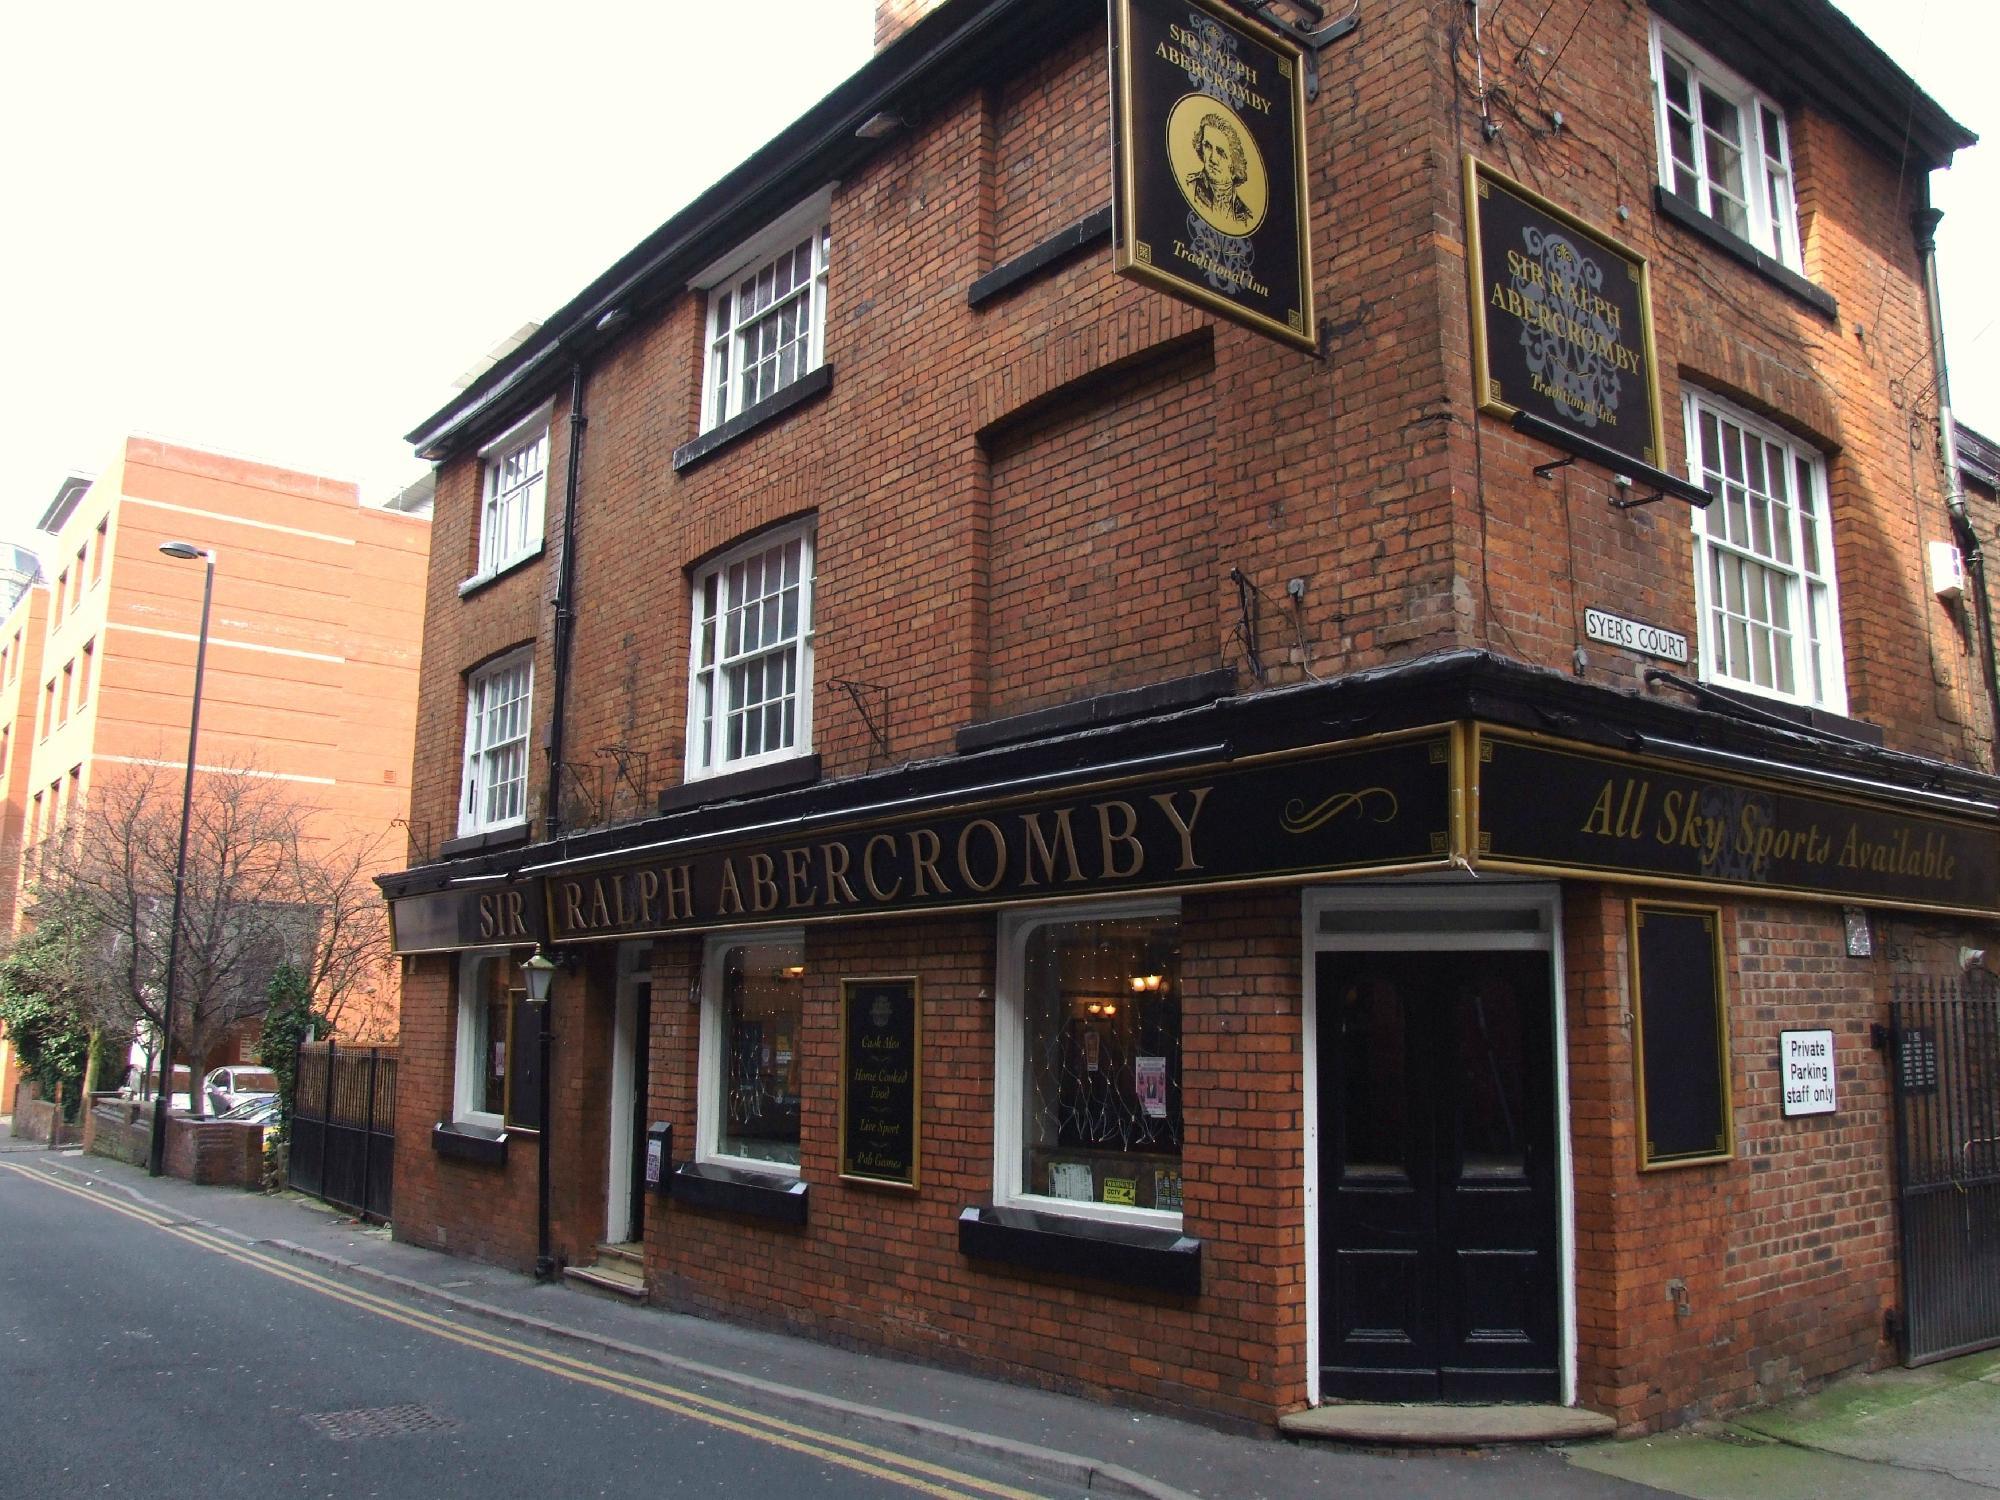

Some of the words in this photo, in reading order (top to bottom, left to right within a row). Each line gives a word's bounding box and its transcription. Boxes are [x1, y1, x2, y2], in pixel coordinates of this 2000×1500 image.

[1169, 23, 1198, 52] SIR
[1200, 38, 1257, 86] RALPH
[1155, 41, 1272, 116] ABERCROMBY
[1173, 239, 1246, 286] Traditional
[1248, 272, 1270, 298] Inn
[1507, 250, 1544, 290] SIR
[1550, 271, 1622, 329] RALPH
[1490, 282, 1641, 377] ABERCROMBY
[1530, 371, 1597, 418] Traditional
[1597, 407, 1618, 426] Inn
[1588, 613, 1633, 644] SYERS
[1638, 628, 1684, 658] COURT
[1580, 778, 1649, 840] All
[1656, 789, 1726, 865] Sky
[1735, 803, 1831, 873] Sports
[1837, 822, 1956, 881] Available
[479, 890, 528, 939] SIR
[562, 865, 696, 930] RALPH
[717, 785, 1215, 916] ABERCROMBY
[861, 1035, 882, 1049] Cask
[1790, 1040, 1825, 1057] Private
[854, 1068, 877, 1082] Home
[878, 1069, 908, 1084] Cooked
[1790, 1063, 1828, 1081] Parking
[870, 1086, 891, 1099] Food
[1786, 1087, 1809, 1104] staff
[1813, 1086, 1834, 1104] only
[859, 1118, 878, 1132] Live
[879, 1119, 900, 1135] Sport
[857, 1151, 874, 1167] Pub
[874, 1153, 901, 1169] Games
[1107, 1180, 1134, 1189] WARNING
